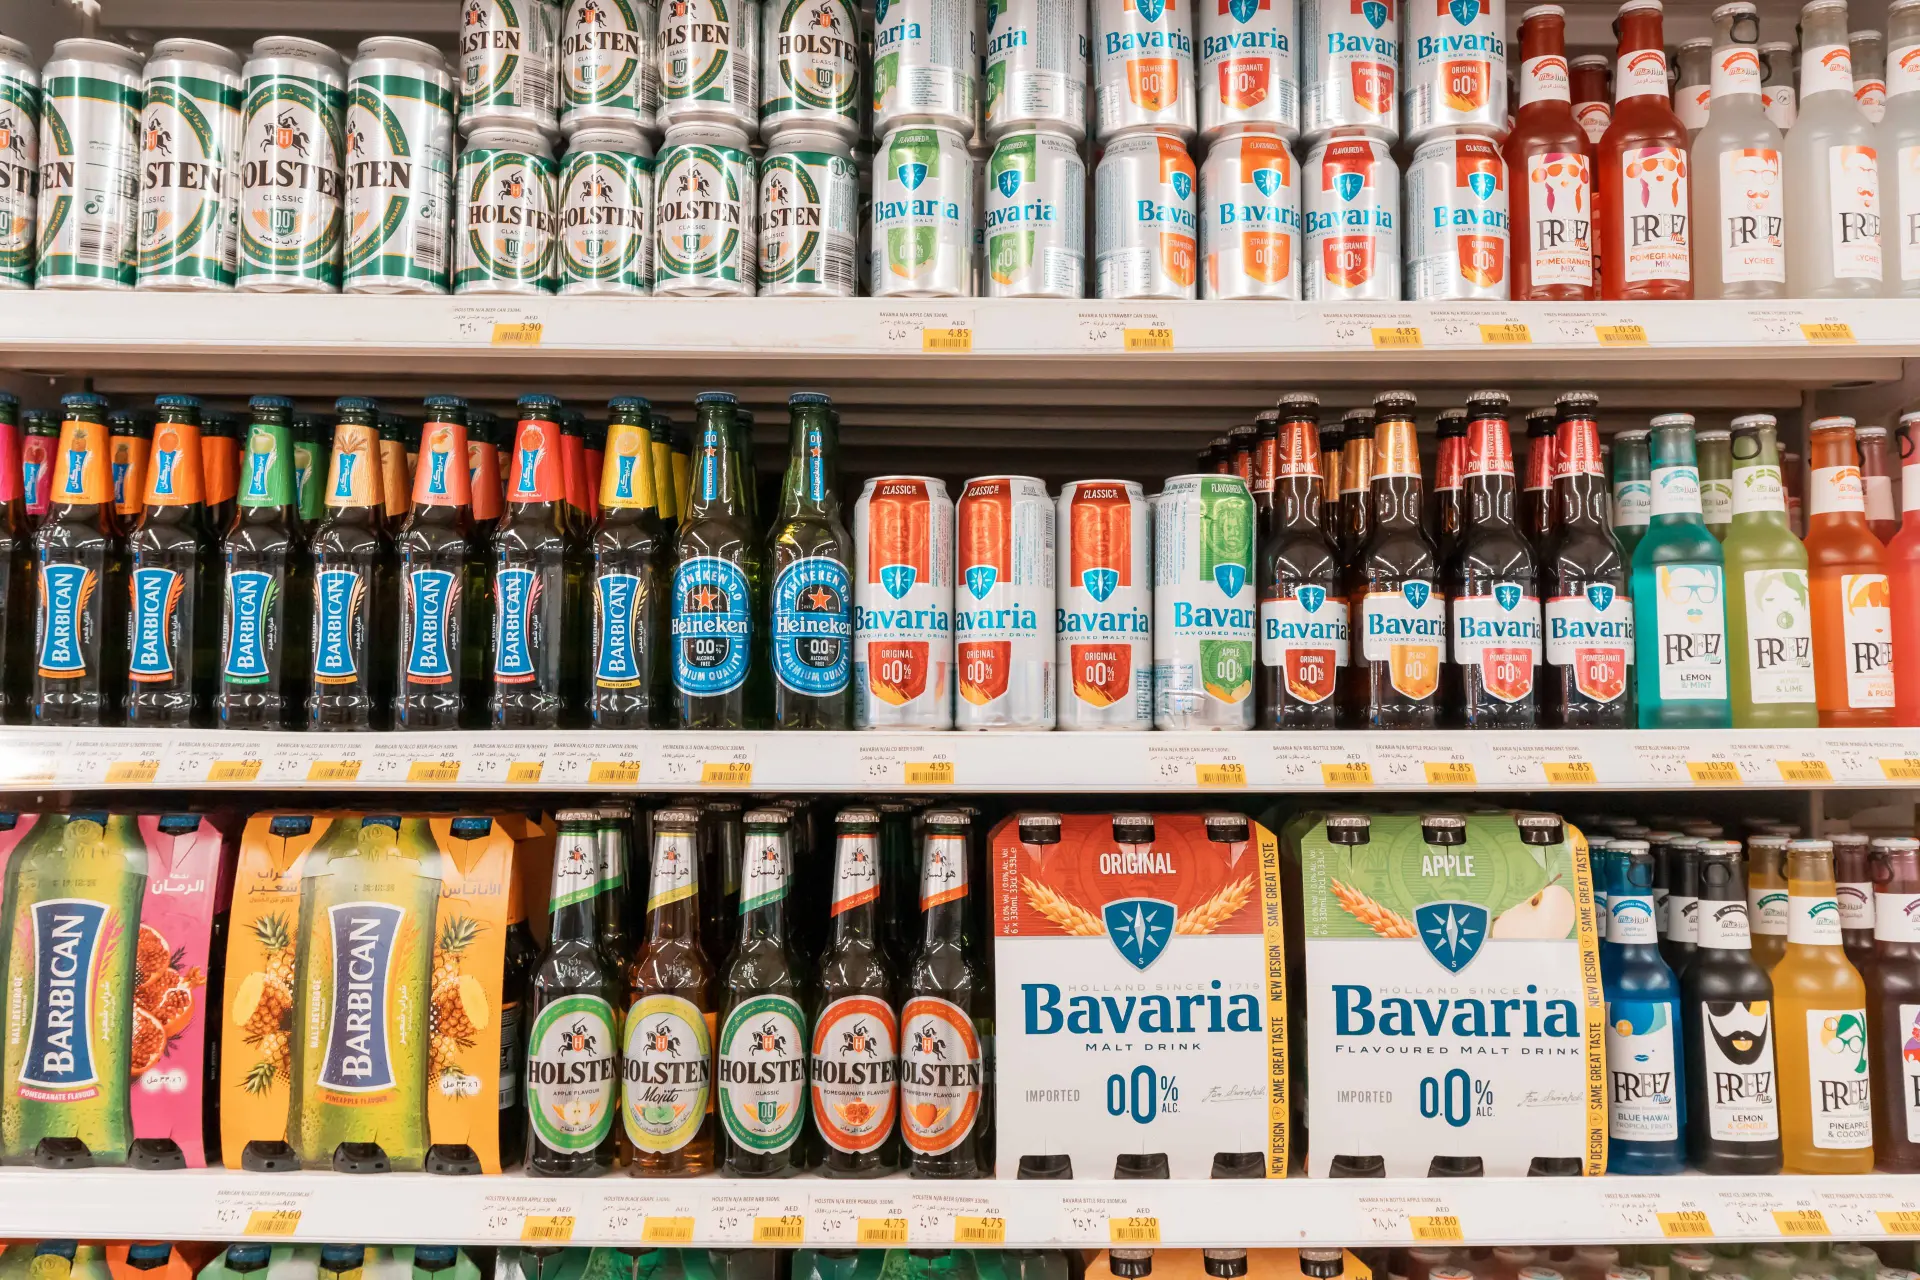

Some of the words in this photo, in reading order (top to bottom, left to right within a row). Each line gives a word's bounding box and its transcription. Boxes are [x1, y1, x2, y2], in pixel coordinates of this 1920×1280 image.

[1106, 28, 1190, 55] Bavaria
[1204, 28, 1288, 59] Bavaria
[1417, 32, 1504, 59] Bavaria
[1452, 66, 1480, 74] ORIGINAL
[875, 196, 959, 223] Bavaria
[1305, 205, 1392, 233] Bavaria
[1630, 252, 1688, 262] POMEGRANATE
[1744, 257, 1775, 265] LYCHEE
[1536, 258, 1591, 267] POMEGRANATE
[520, 322, 541, 332] 3.90
[1396, 327, 1417, 336] 4.85
[1504, 324, 1526, 332] 4.50
[1613, 325, 1641, 333] 10.50
[1818, 323, 1847, 332] 10.50
[948, 329, 969, 338] 4.85
[1149, 329, 1169, 338] 4.85
[1281, 461, 1316, 474] ORIGINAL
[882, 485, 912, 494] CLASSIC
[968, 486, 993, 497] CLASSIC
[1084, 489, 1113, 499] CLASSIC
[51, 573, 73, 662] BARBICAN
[140, 576, 162, 666] BARBICAN
[855, 604, 949, 631] Bavaria
[237, 580, 257, 669] BARBICAN
[325, 579, 344, 668] BARBICAN
[420, 578, 441, 668] BARBICAN
[504, 578, 521, 668] BARBICAN
[608, 582, 627, 672] BARBICAN
[672, 616, 748, 636] Heineken
[776, 616, 852, 636] Heineken
[1266, 618, 1347, 640] Bavaria
[881, 649, 913, 659] ORIGINAL
[966, 650, 995, 659] ORIGINAL
[1085, 652, 1117, 660] ORIGINAL
[1222, 648, 1240, 657] APPLE
[1489, 653, 1528, 662] POMEGRANATE
[1582, 653, 1621, 662] POMEGRANATE
[1300, 655, 1325, 663] ORIGINAL
[1784, 685, 1803, 693] LIME
[241, 759, 262, 768] 4.25
[340, 759, 361, 768] 4.25
[619, 760, 641, 769] 4.25
[729, 762, 751, 772] 6.70
[929, 762, 951, 771] 4.95
[1220, 763, 1242, 772] 4.95
[1346, 762, 1368, 772] 4.85
[1568, 763, 1590, 772] 4.85
[1705, 761, 1734, 771] 10.50
[1801, 760, 1824, 769] 9.90
[1262, 842, 1275, 871] TASTE
[1100, 852, 1177, 875] ORIGINAL
[1421, 855, 1476, 877] APPLE
[1264, 871, 1278, 900] GREAT
[1267, 901, 1279, 927] SAME
[1268, 945, 1282, 979] DESIGN
[1068, 984, 1147, 993] HOLLAND
[1155, 983, 1205, 992] SINCE
[1270, 980, 1283, 1002] NEW
[1379, 987, 1459, 995] HOLLAND
[1469, 987, 1520, 995] SINCE
[43, 914, 85, 1075] BARBICAN
[342, 917, 382, 1079] BARBICAN
[1021, 979, 1263, 1035] Bavaria
[1331, 984, 1581, 1037] Bavaria
[1085, 1043, 1134, 1051] MALT
[1144, 1042, 1202, 1051] DRINK
[1335, 1045, 1449, 1054] FLAVOURED
[1460, 1046, 1510, 1055] MALT
[1521, 1047, 1580, 1055] DRINK
[528, 1056, 618, 1084] HOLSTEN
[622, 1059, 710, 1084] HOLSTEN
[720, 1058, 807, 1083] HOLSTEN
[812, 1060, 899, 1084] HOLSTEN
[20, 1089, 67, 1101] POMEGRANATE
[67, 1088, 97, 1101] FLAVOUR
[574, 1088, 600, 1096] FLAVOUR
[638, 1086, 682, 1103] Mojito
[1025, 1089, 1081, 1103] IMPORTED
[1337, 1090, 1393, 1103] IMPORTED
[1161, 1103, 1180, 1113] ALC.
[1476, 1106, 1496, 1117] ALC.
[1618, 1113, 1641, 1121] BLUE
[1732, 1114, 1764, 1122] LEMON
[1829, 1122, 1869, 1130] PINEAPPLE
[272, 1209, 302, 1219] 24.60
[1676, 1211, 1706, 1221] 10.50
[1798, 1210, 1822, 1220] 9.80
[551, 1216, 573, 1225] 4.75
[781, 1214, 802, 1225] 4.75
[884, 1218, 906, 1228] 4.75
[981, 1217, 1003, 1228] 4.75
[1128, 1217, 1157, 1227] 25.20
[1428, 1215, 1457, 1226] 28.80
